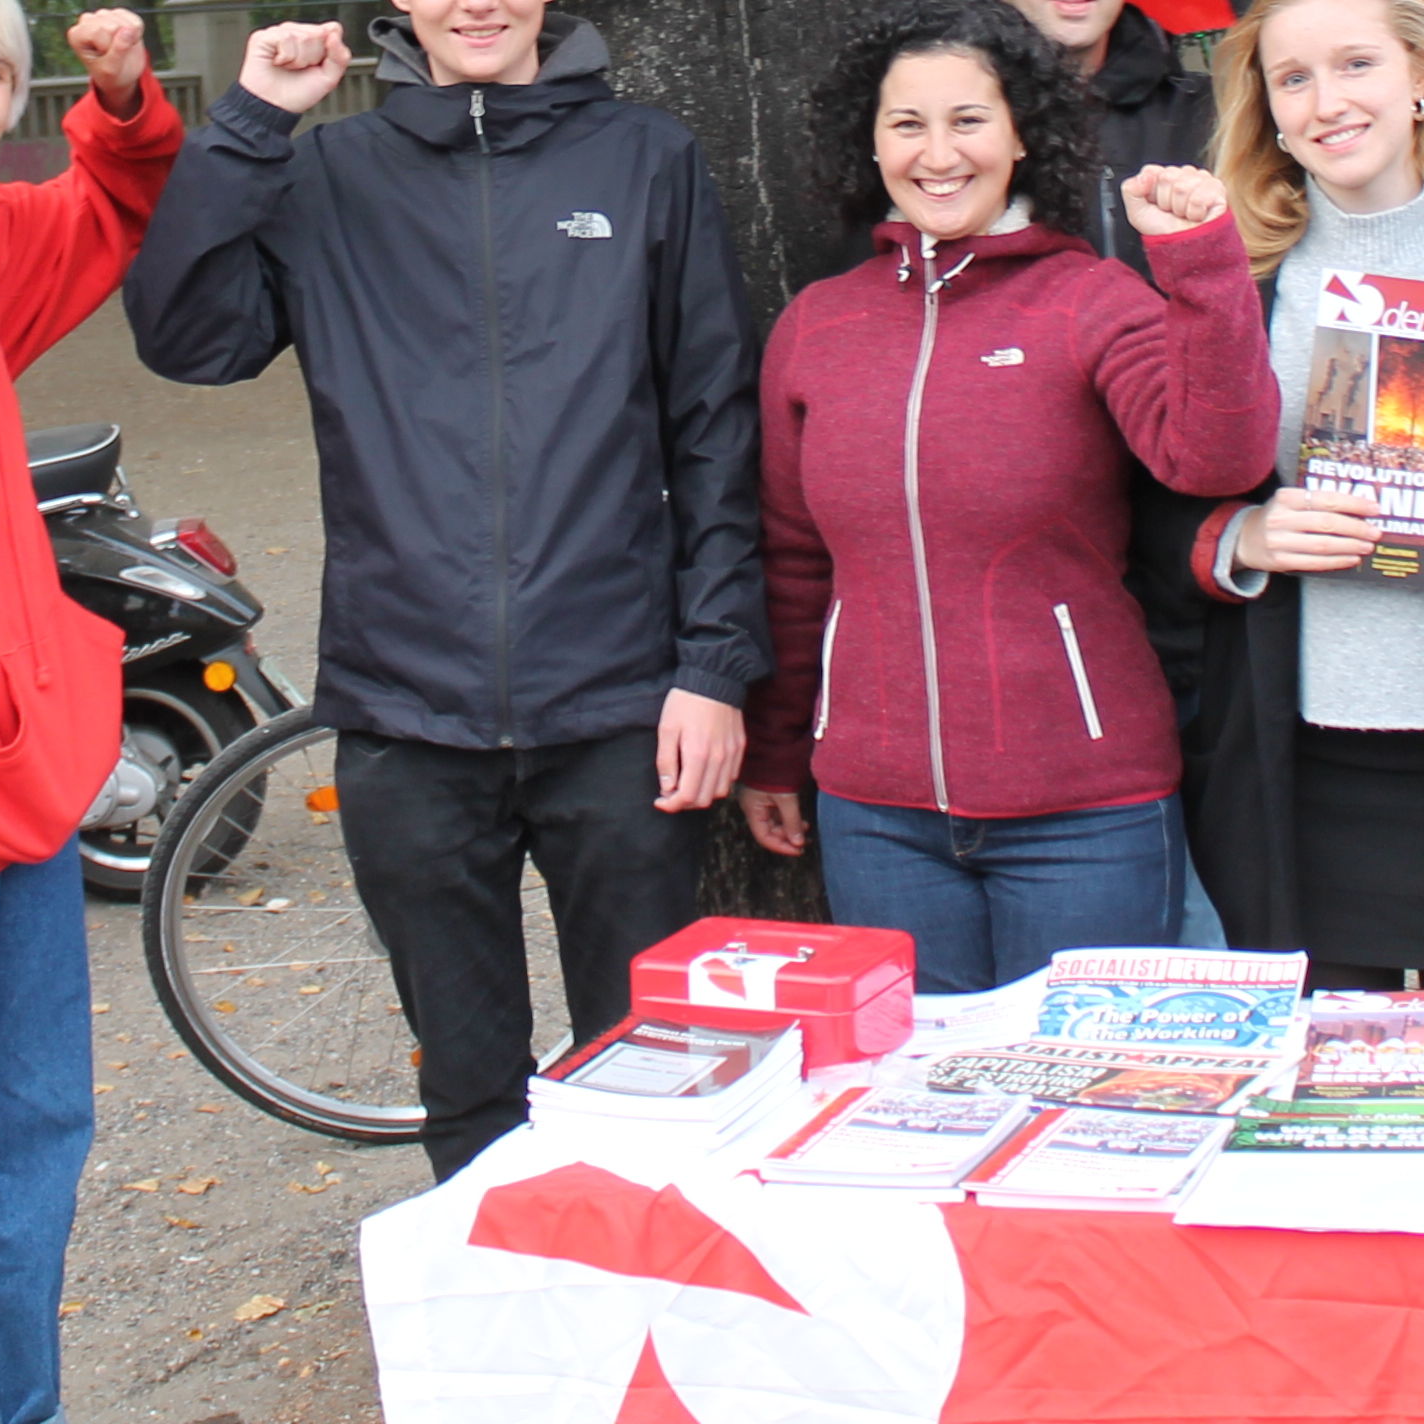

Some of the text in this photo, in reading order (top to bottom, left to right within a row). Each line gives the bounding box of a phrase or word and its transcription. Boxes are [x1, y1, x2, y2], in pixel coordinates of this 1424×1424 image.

[1054, 958, 1300, 981] SOCIALIST REVOLUTION
[1091, 1007, 1252, 1024] The Power of
[1089, 1026, 1238, 1042] the Working
[938, 1056, 1109, 1079] CAPITALISM
[1143, 1053, 1273, 1070] APPEAL
